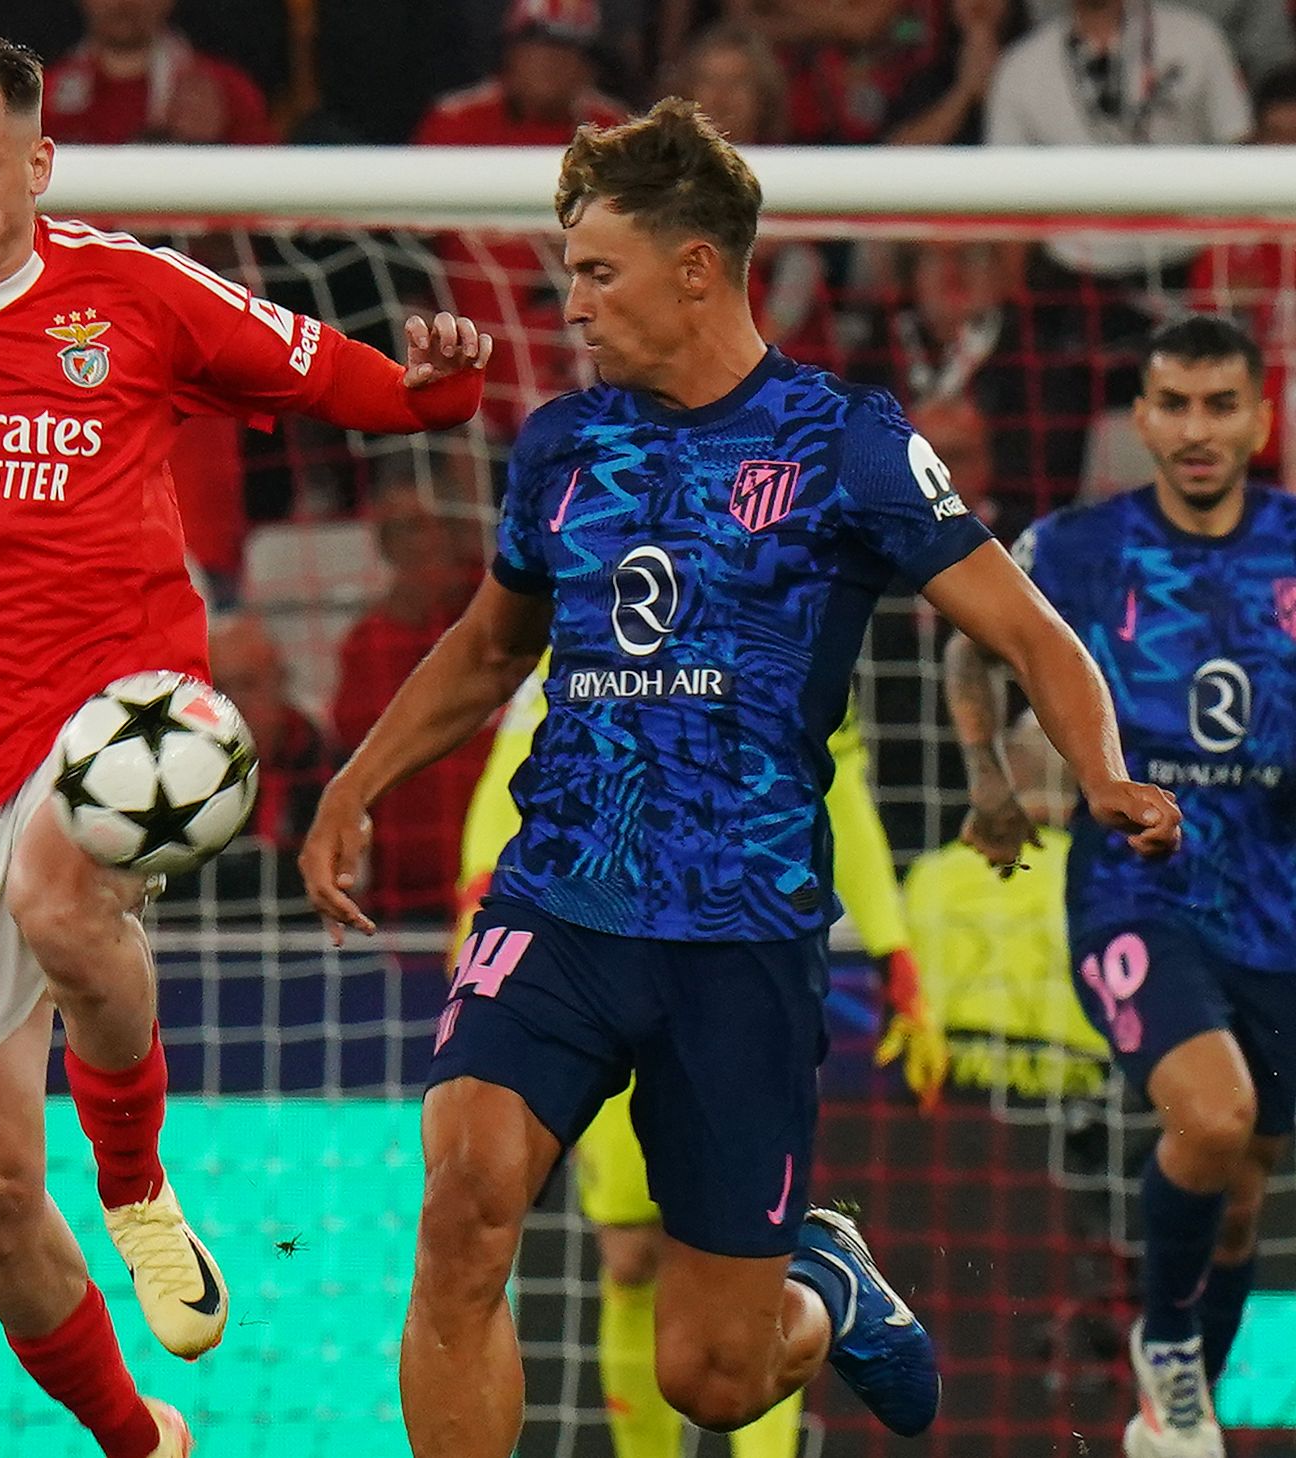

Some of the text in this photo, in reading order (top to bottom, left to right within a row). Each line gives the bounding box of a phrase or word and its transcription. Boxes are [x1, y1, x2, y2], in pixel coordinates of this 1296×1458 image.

[289, 314, 322, 377] Beta
[569, 669, 723, 699] RIYADH AIR
